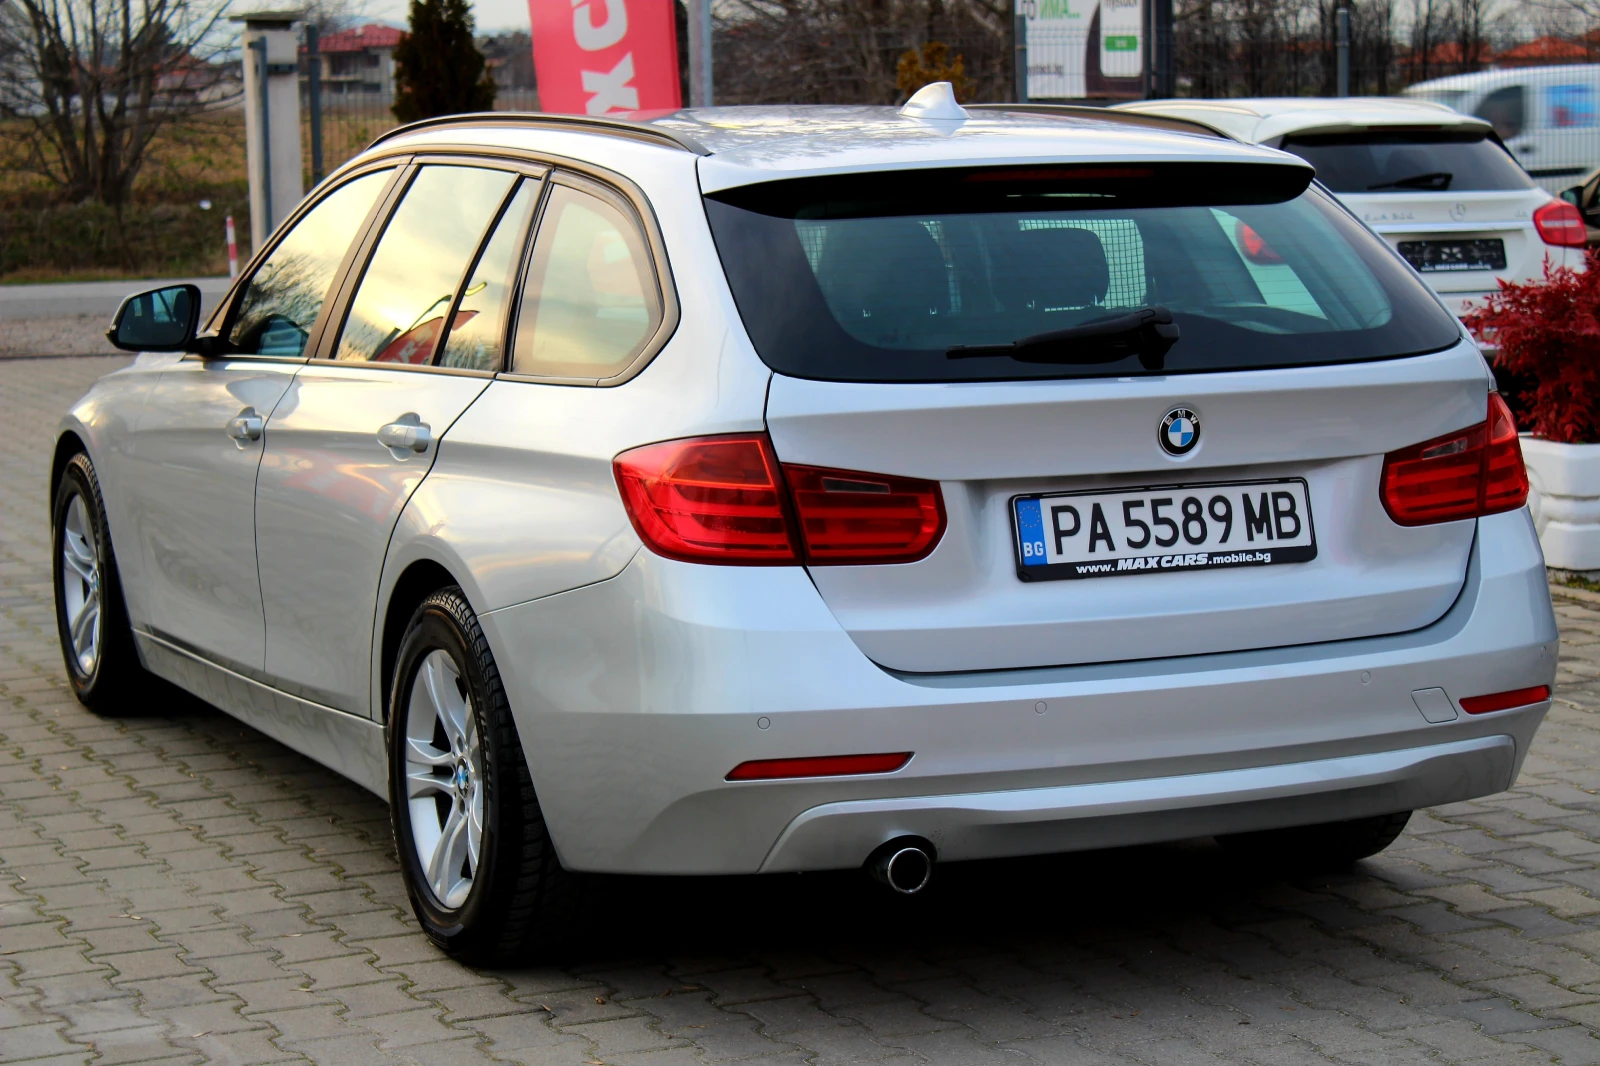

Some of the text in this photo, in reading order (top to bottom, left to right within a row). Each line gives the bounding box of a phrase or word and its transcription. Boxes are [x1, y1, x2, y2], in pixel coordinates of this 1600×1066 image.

[1164, 410, 1198, 425] BMW
[1122, 494, 1233, 549] 5589
[1242, 488, 1301, 541] MB
[1023, 541, 1044, 557] BG
